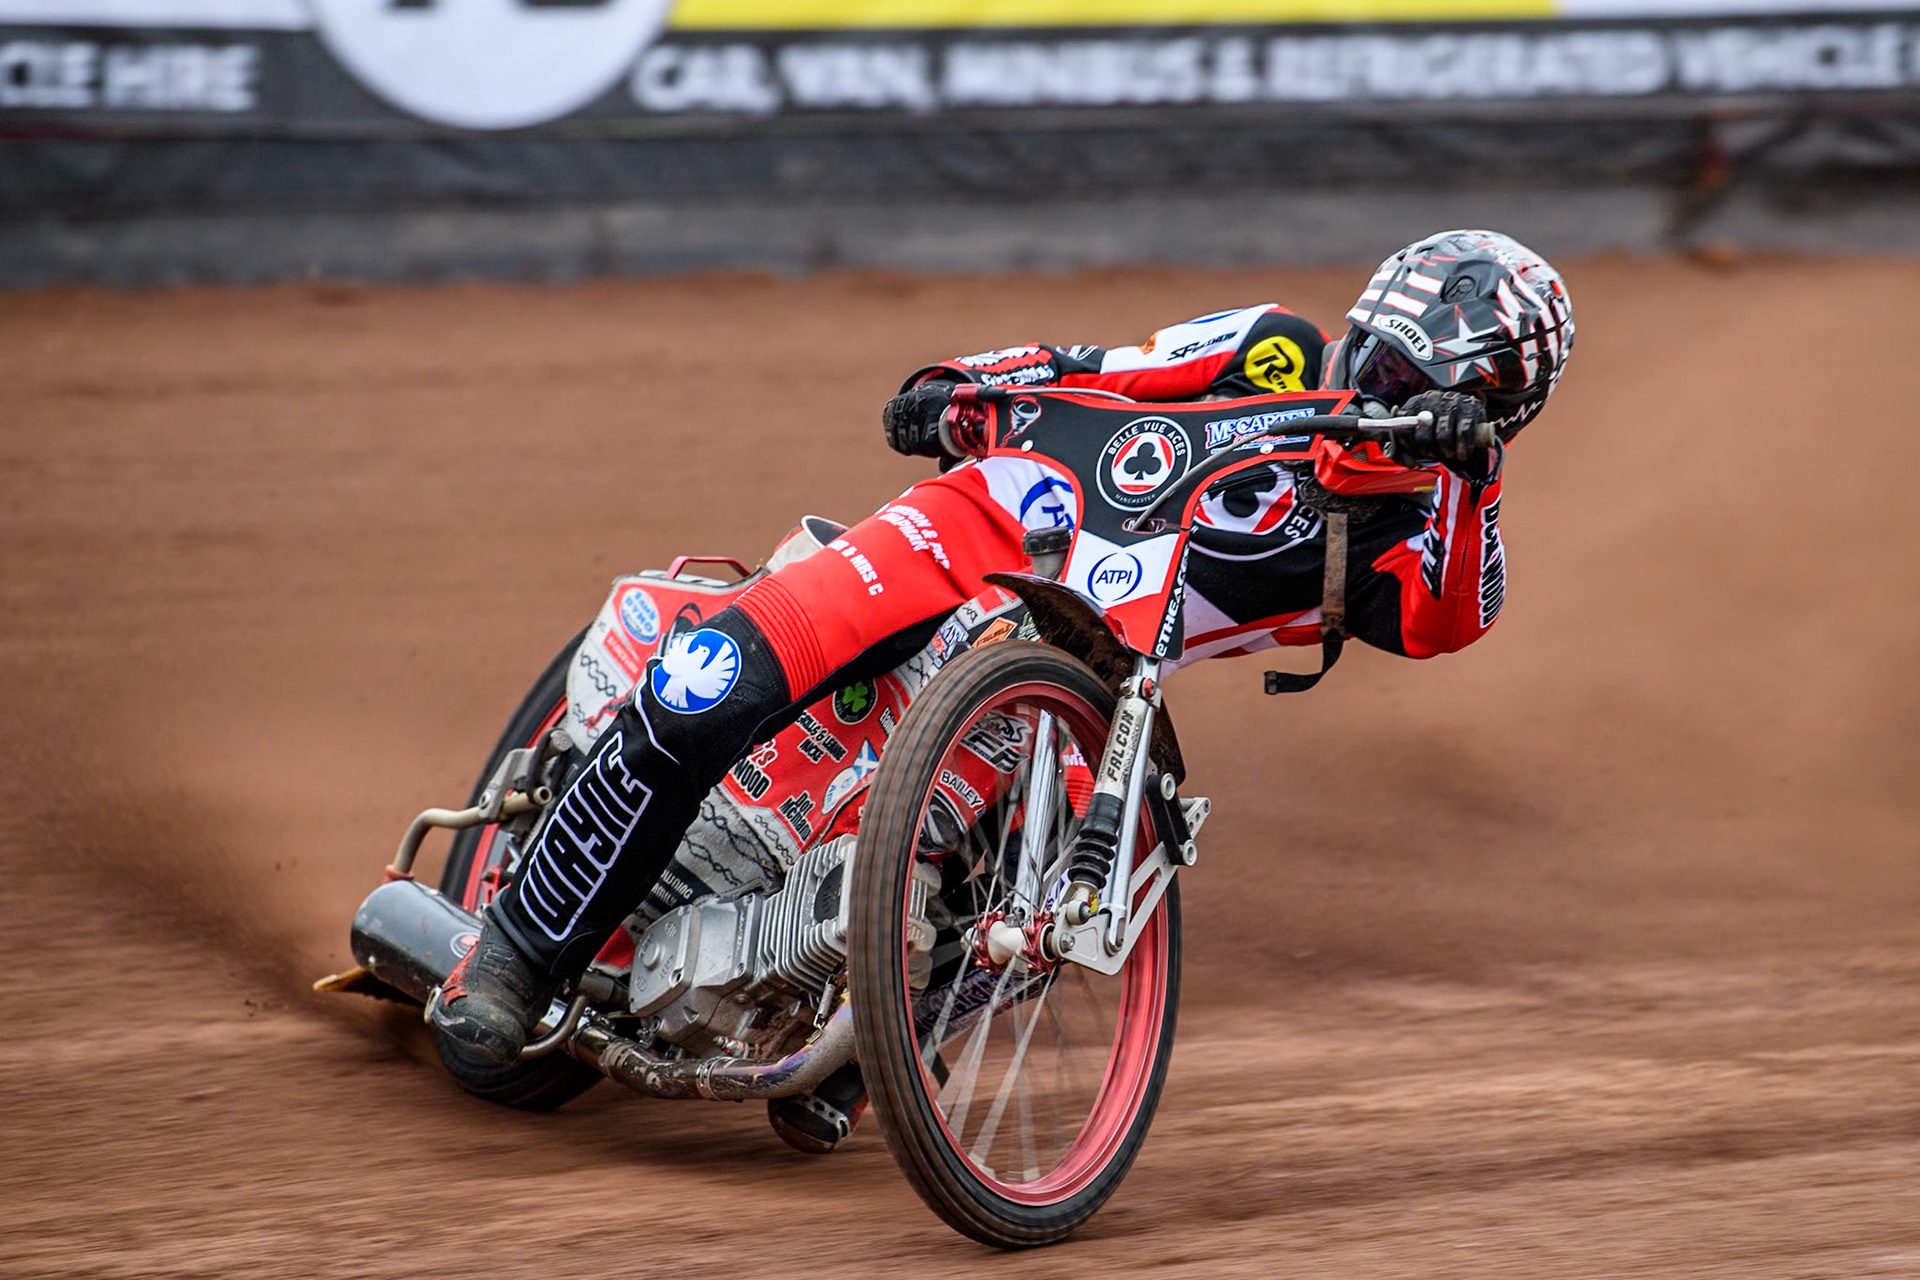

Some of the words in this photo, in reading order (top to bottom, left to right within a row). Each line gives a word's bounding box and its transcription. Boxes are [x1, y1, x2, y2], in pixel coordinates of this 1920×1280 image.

[1387, 318, 1427, 354] SHOEI
[1107, 425, 1140, 456] BELLE
[1143, 421, 1168, 434] VUE
[1167, 430, 1186, 457] ACES
[1114, 493, 1156, 504] MANCHESTER
[1284, 502, 1315, 538] CES
[850, 554, 878, 583] MRS
[1095, 569, 1134, 586] ATPI
[1107, 709, 1134, 782] FALCON
[941, 771, 983, 807] BAILEY
[519, 731, 652, 941] WAYNE
